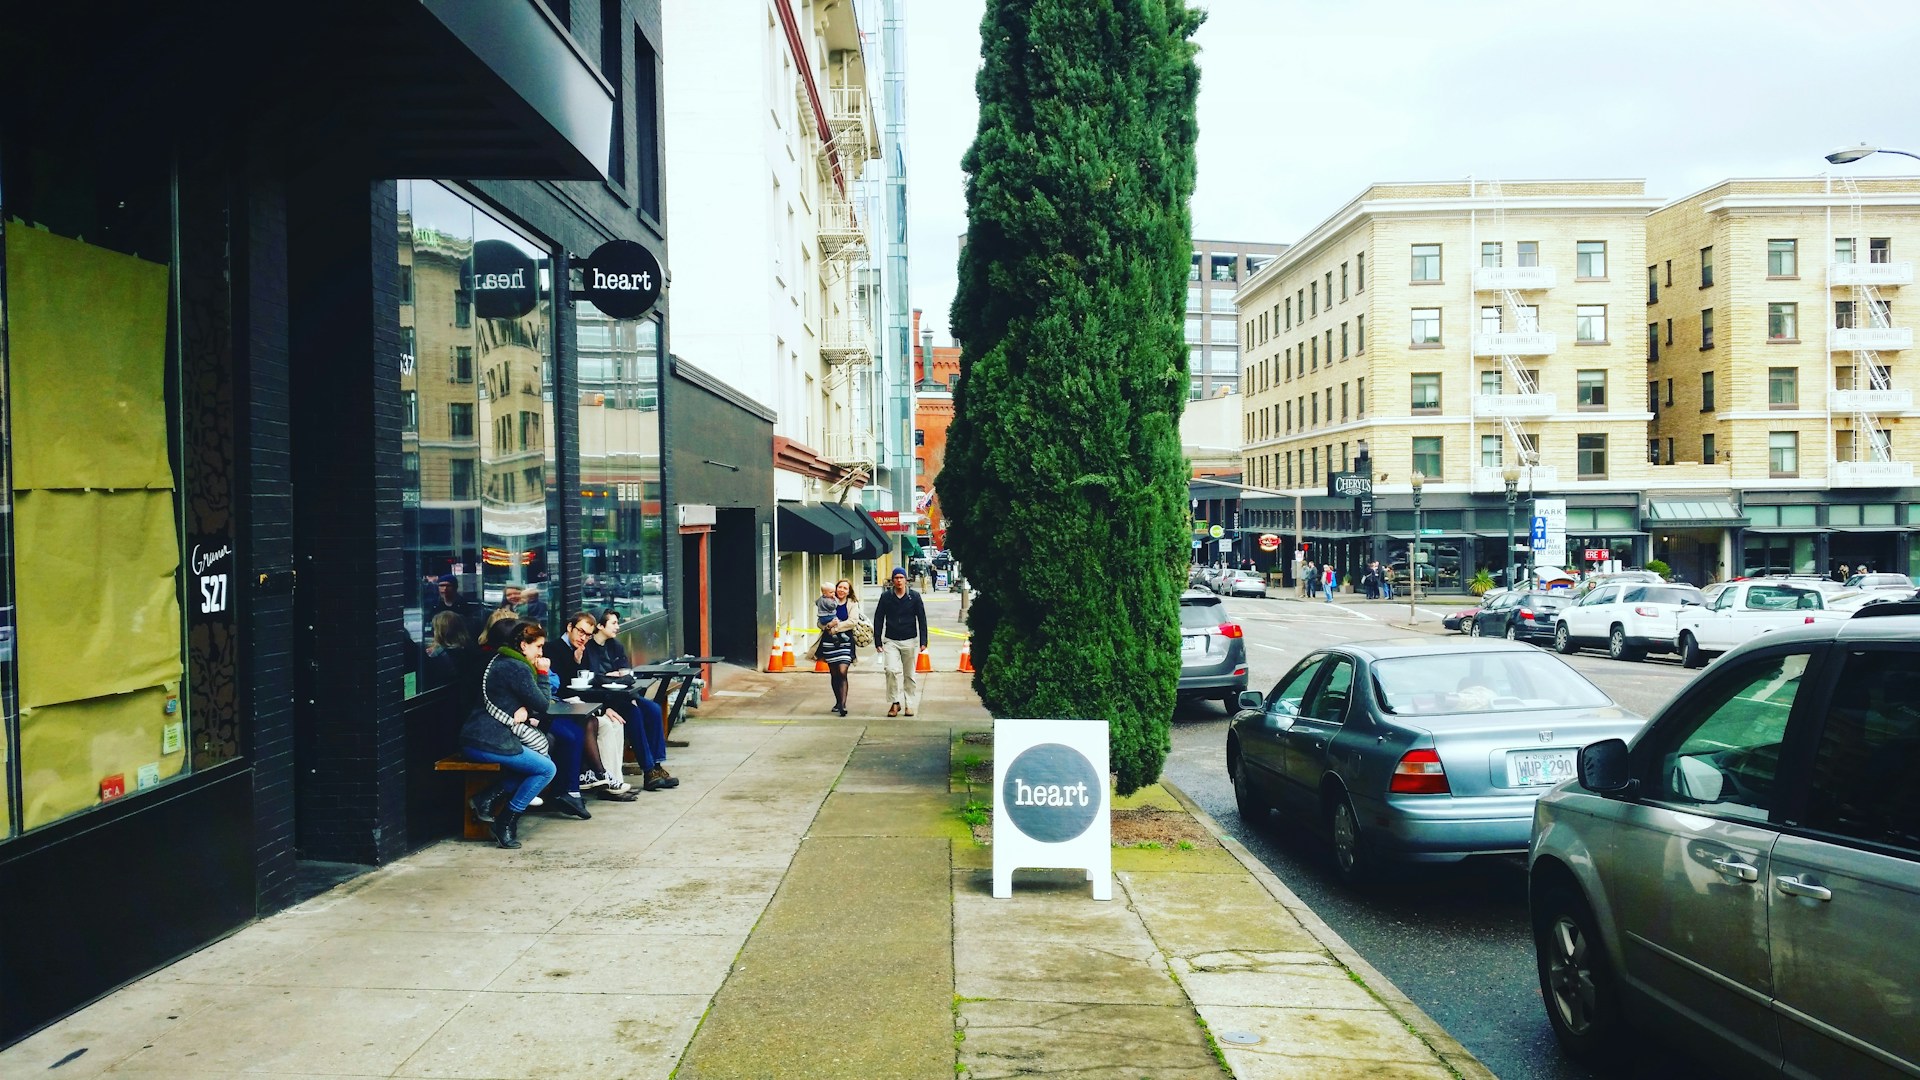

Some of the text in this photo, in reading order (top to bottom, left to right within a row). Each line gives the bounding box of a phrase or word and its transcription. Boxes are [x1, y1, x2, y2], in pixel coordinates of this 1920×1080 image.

[592, 268, 652, 291] heart
[1336, 477, 1371, 492] CHERYL'S
[1533, 518, 1545, 548] ATM
[201, 574, 227, 613] 527
[1518, 759, 1573, 777] WUP 290
[1015, 779, 1089, 807] heart
